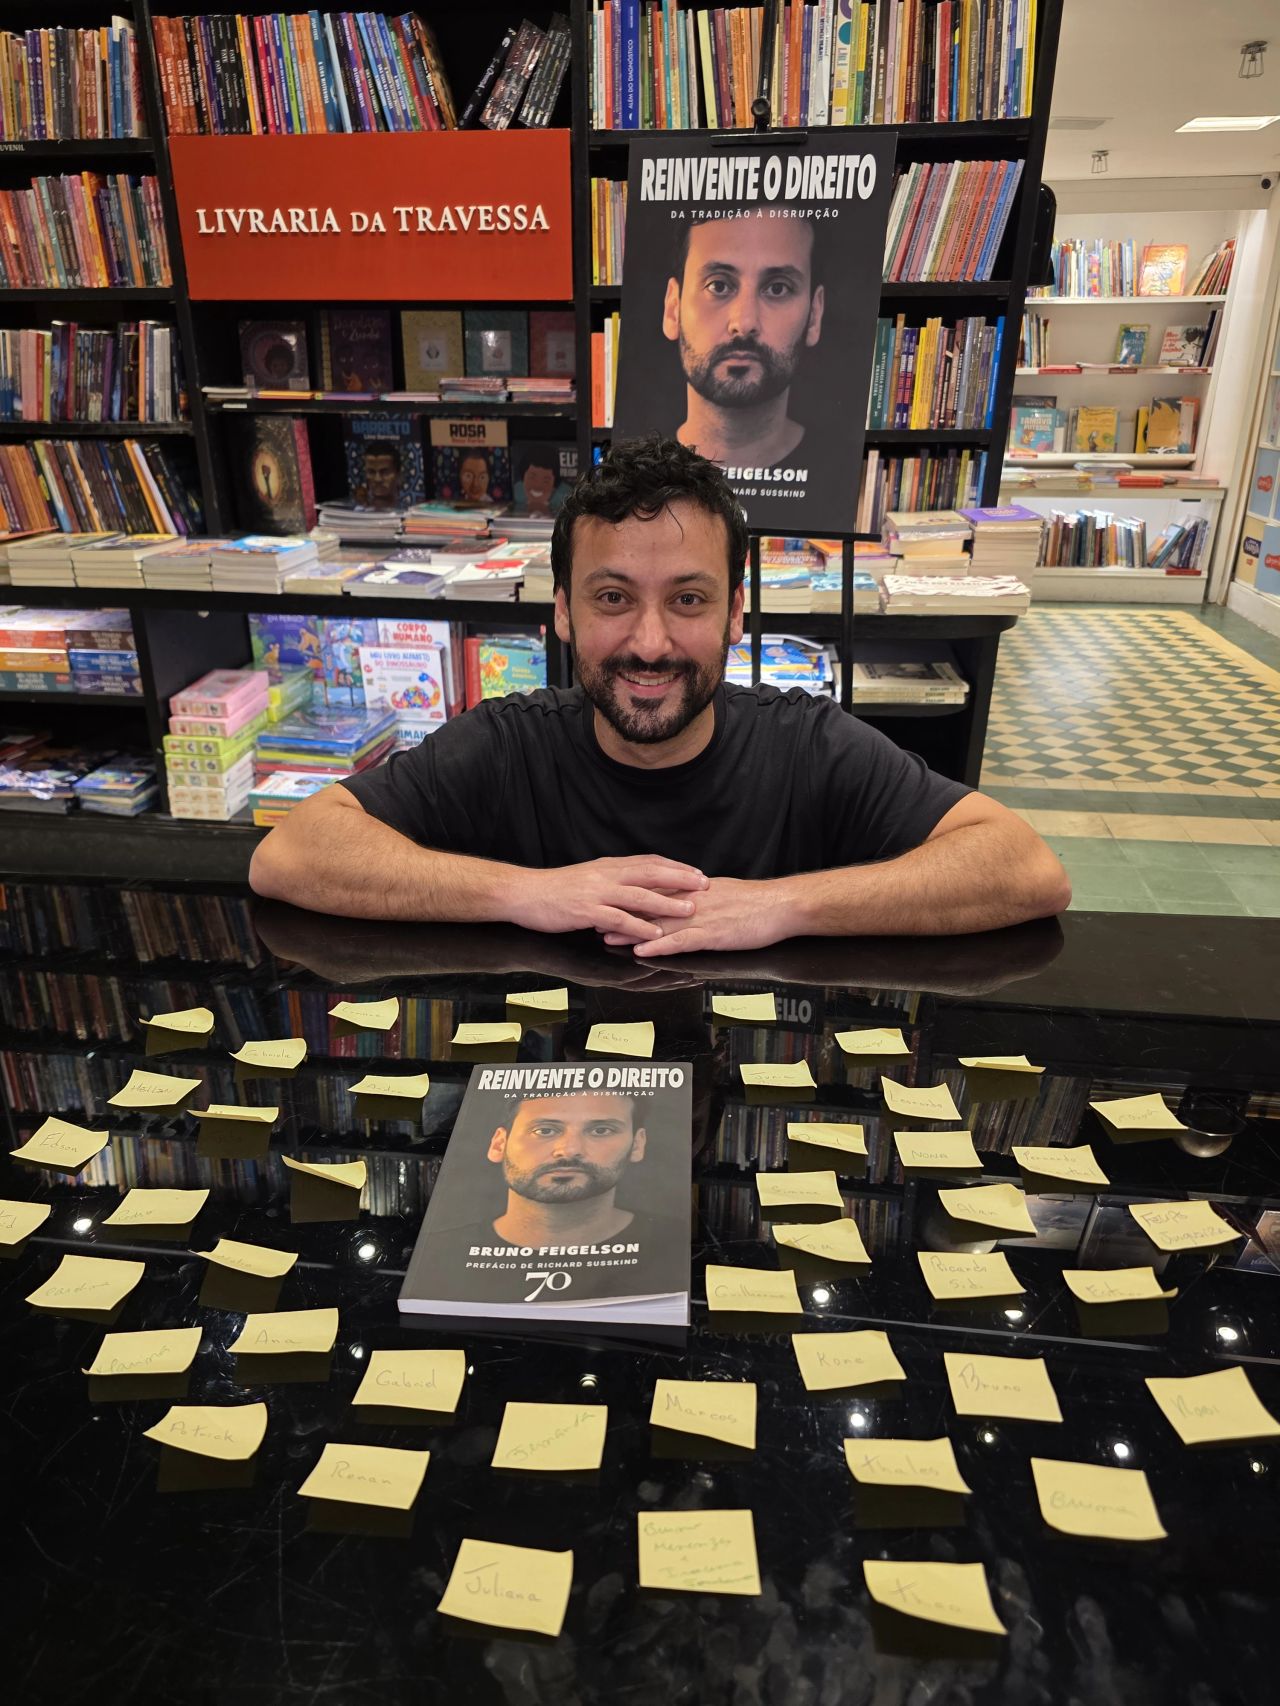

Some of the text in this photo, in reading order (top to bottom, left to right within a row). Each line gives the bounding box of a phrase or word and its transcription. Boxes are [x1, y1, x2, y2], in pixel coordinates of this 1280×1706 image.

[628, 83, 633, 92] DO
[640, 153, 877, 201] REINVENTE O DIREITO
[195, 205, 550, 233] LIVRARIA DA TRAVESSA
[670, 207, 839, 220] DA TRADIÇÃO À DISRUPÇÃO
[449, 423, 487, 438] ROSA
[732, 488, 806, 498] HARD SUSSKIND
[397, 623, 428, 632] CORPO
[393, 633, 433, 643] HUMANO
[478, 1067, 684, 1090] REINVENTE O DIREITO
[469, 1243, 640, 1257] BRUNO FEIGELSON
[466, 1261, 517, 1269] PREFÁCIO
[587, 1259, 638, 1267] SUSSKIND
[524, 1271, 572, 1302] 70
